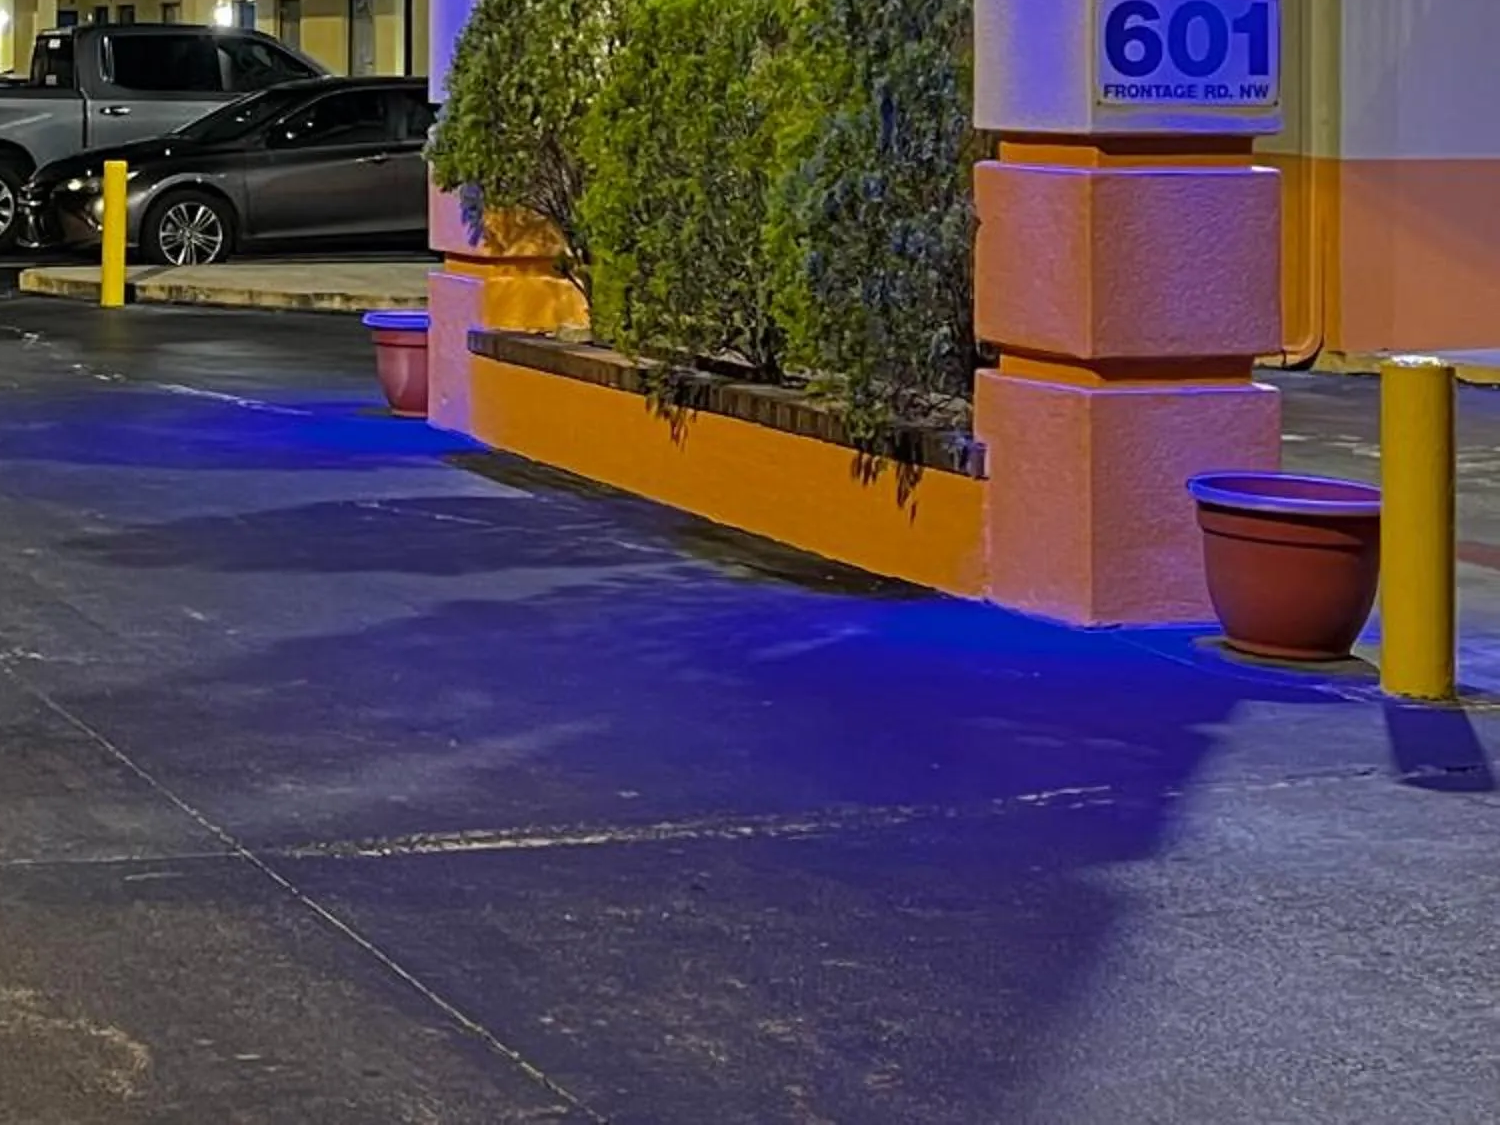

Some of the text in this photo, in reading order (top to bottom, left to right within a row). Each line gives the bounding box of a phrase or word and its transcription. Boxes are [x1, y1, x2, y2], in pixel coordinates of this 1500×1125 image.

[1105, 0, 1269, 78] 601
[1103, 83, 1269, 99] FRONTAGE RD. NW
